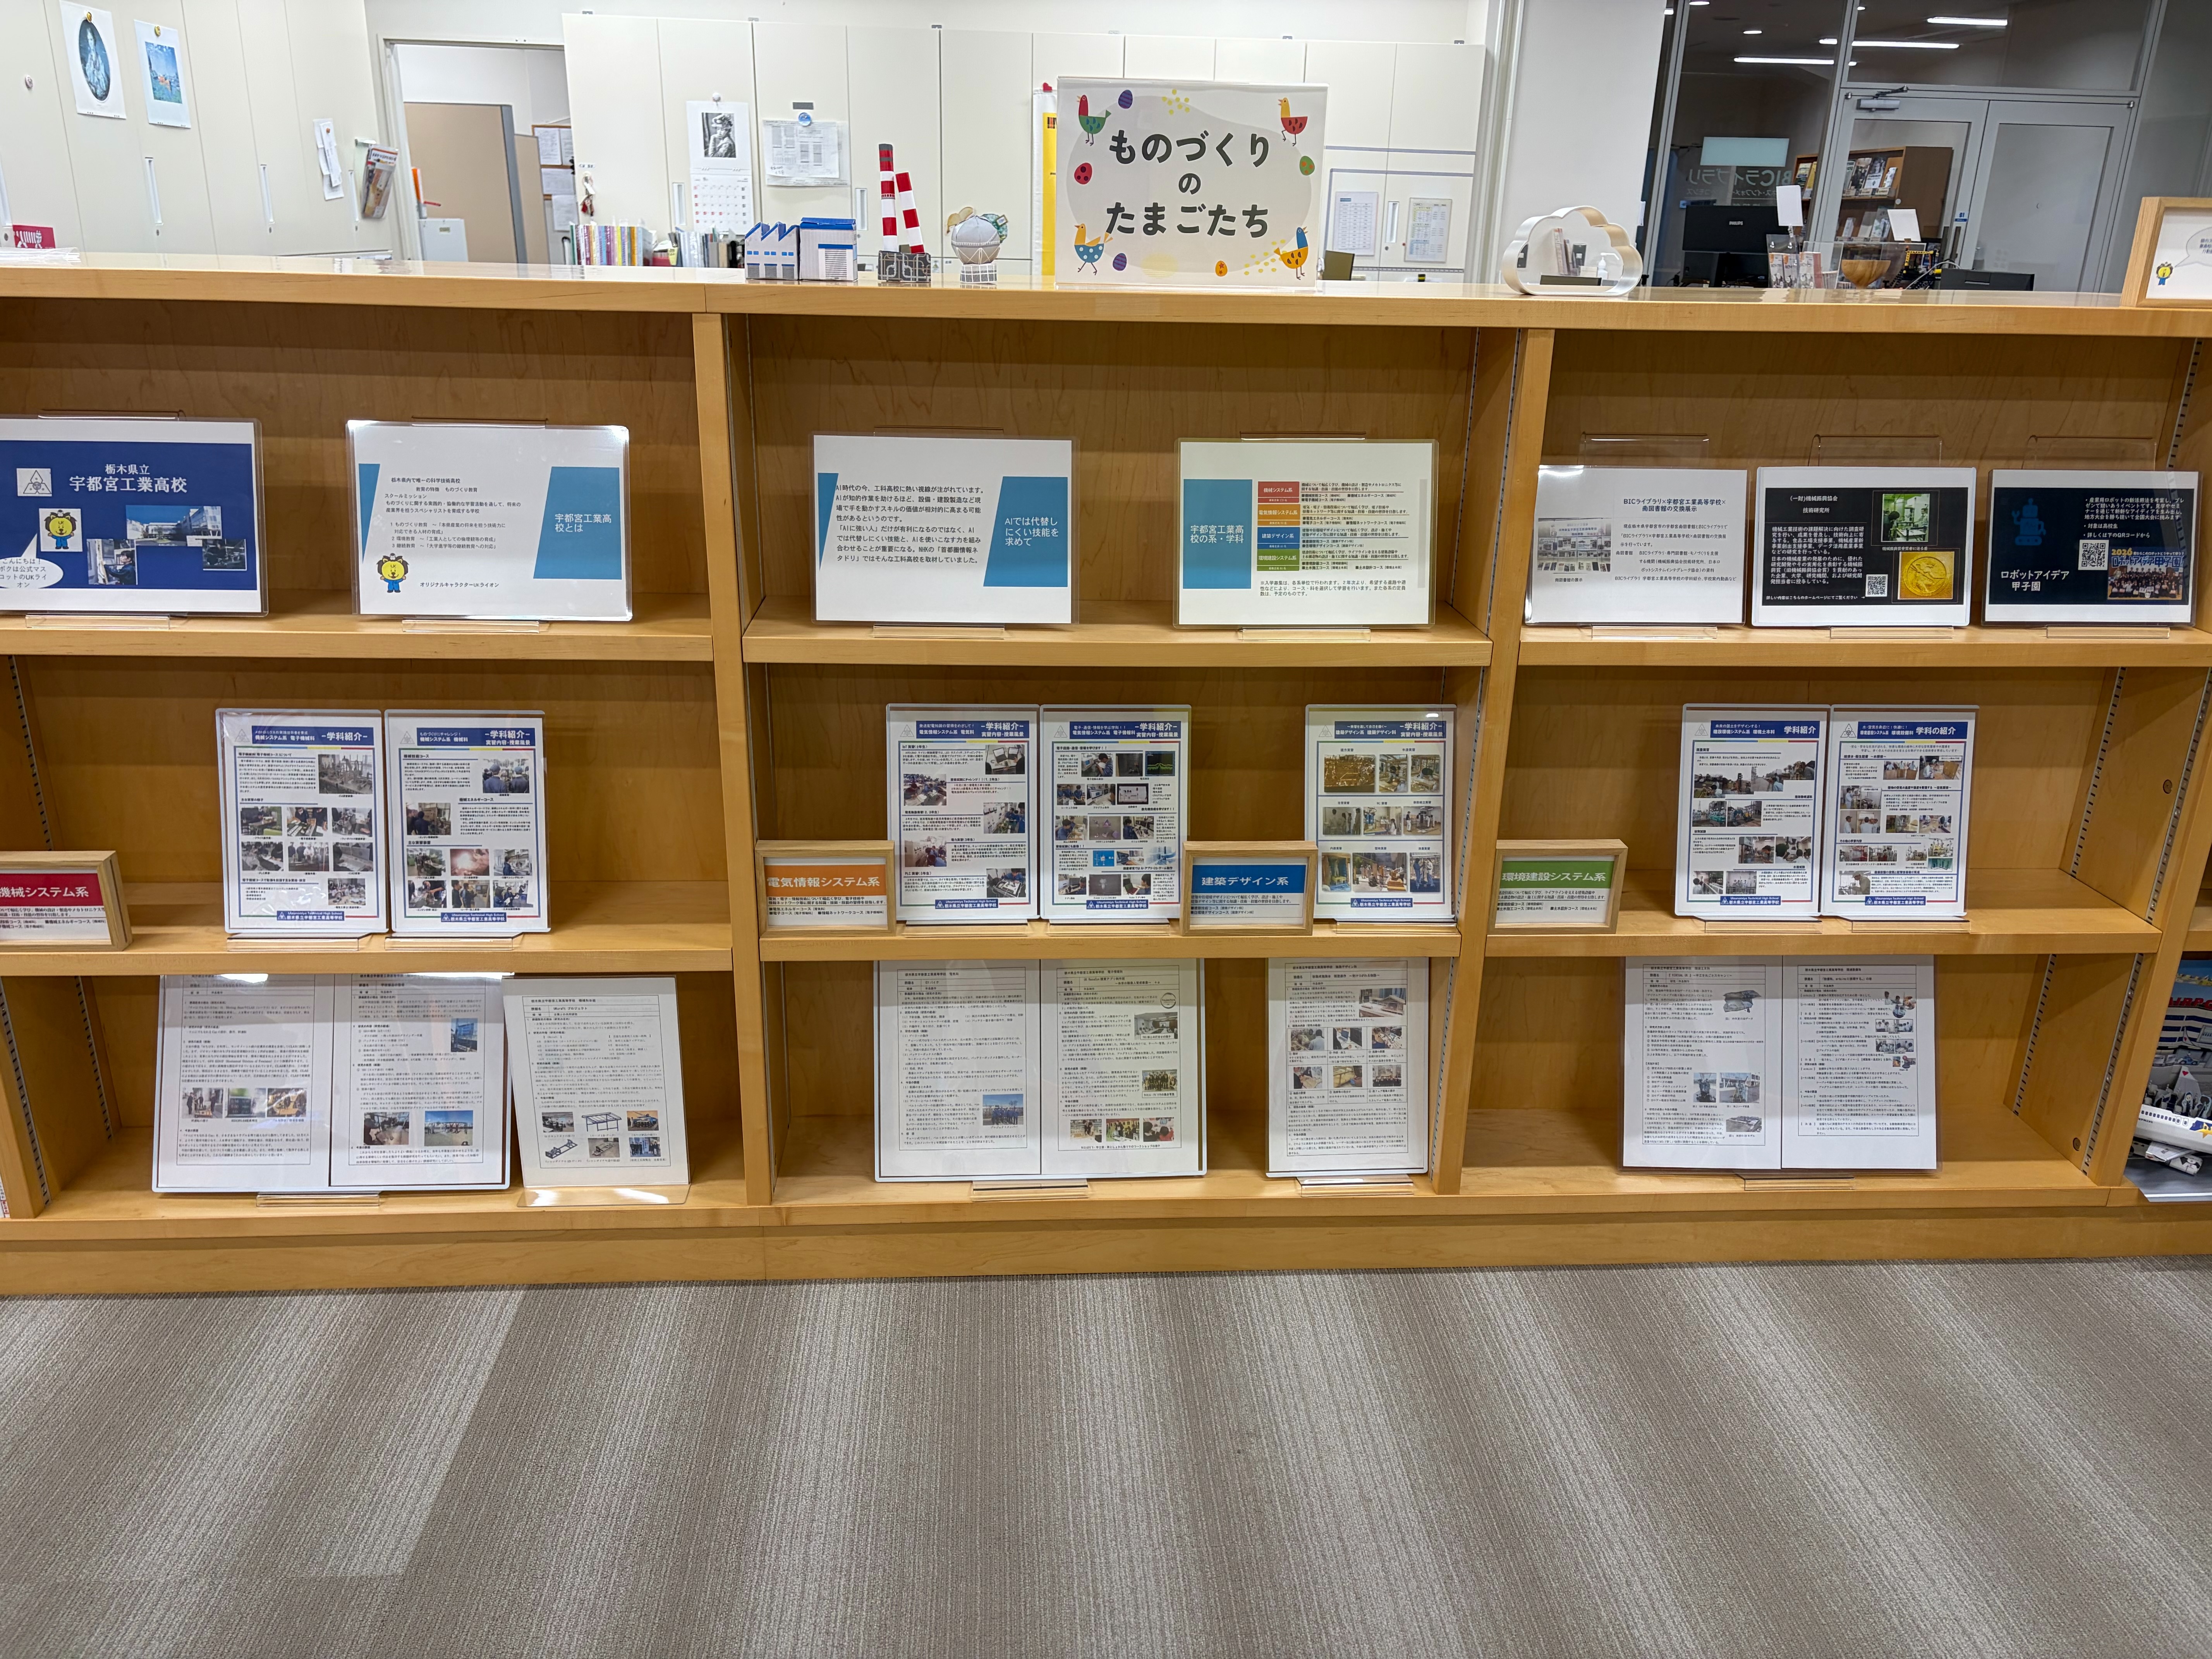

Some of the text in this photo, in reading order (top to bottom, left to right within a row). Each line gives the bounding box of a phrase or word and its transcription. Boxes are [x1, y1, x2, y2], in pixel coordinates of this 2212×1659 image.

[1109, 130, 1269, 167] ものづくり
[1178, 173, 1201, 194] の
[1106, 202, 1268, 238] たまごたち
[105, 464, 150, 475] 栃木県立
[70, 476, 187, 493] 宇都宮工業高校
[836, 485, 984, 494] AI時代の今、工科高校に熱い視線が注がれています。
[836, 495, 981, 503] AIが知的作業を助けるほど、設備・建設製造など現
[836, 505, 981, 514] 場で手を動かすスキルの価値が相対的に高まる可能
[555, 513, 611, 524] 宇都宮工業高
[1005, 517, 1058, 526] AIでは代替し
[555, 524, 583, 533] 校とは
[839, 525, 974, 534] 「AIに強い人」だけが有利になるのではなく、AI
[1005, 528, 1059, 537] にくい技能を
[1190, 525, 1244, 534] 宇都宮工業高
[837, 535, 981, 544] では代替しにくい技能と、AIを使いこなす力を組み
[1005, 537, 1031, 546] 求めて
[1190, 534, 1244, 543] 校の系・学科
[2111, 548, 2133, 556] 2026
[837, 555, 978, 563] タドリ」ではそんな工科高校を取材していました。
[2001, 570, 2069, 580] ロボットアイデア
[2012, 581, 2041, 592] 甲子園
[1784, 726, 1816, 734] 学科紹介
[1916, 726, 1956, 735] 学科の紹介
[1502, 872, 1606, 881] 環境建設システム系
[767, 876, 880, 888] 電気情報システム系
[1202, 877, 1288, 886] 建築デザイン系
[0, 886, 89, 898] 機械システム系
